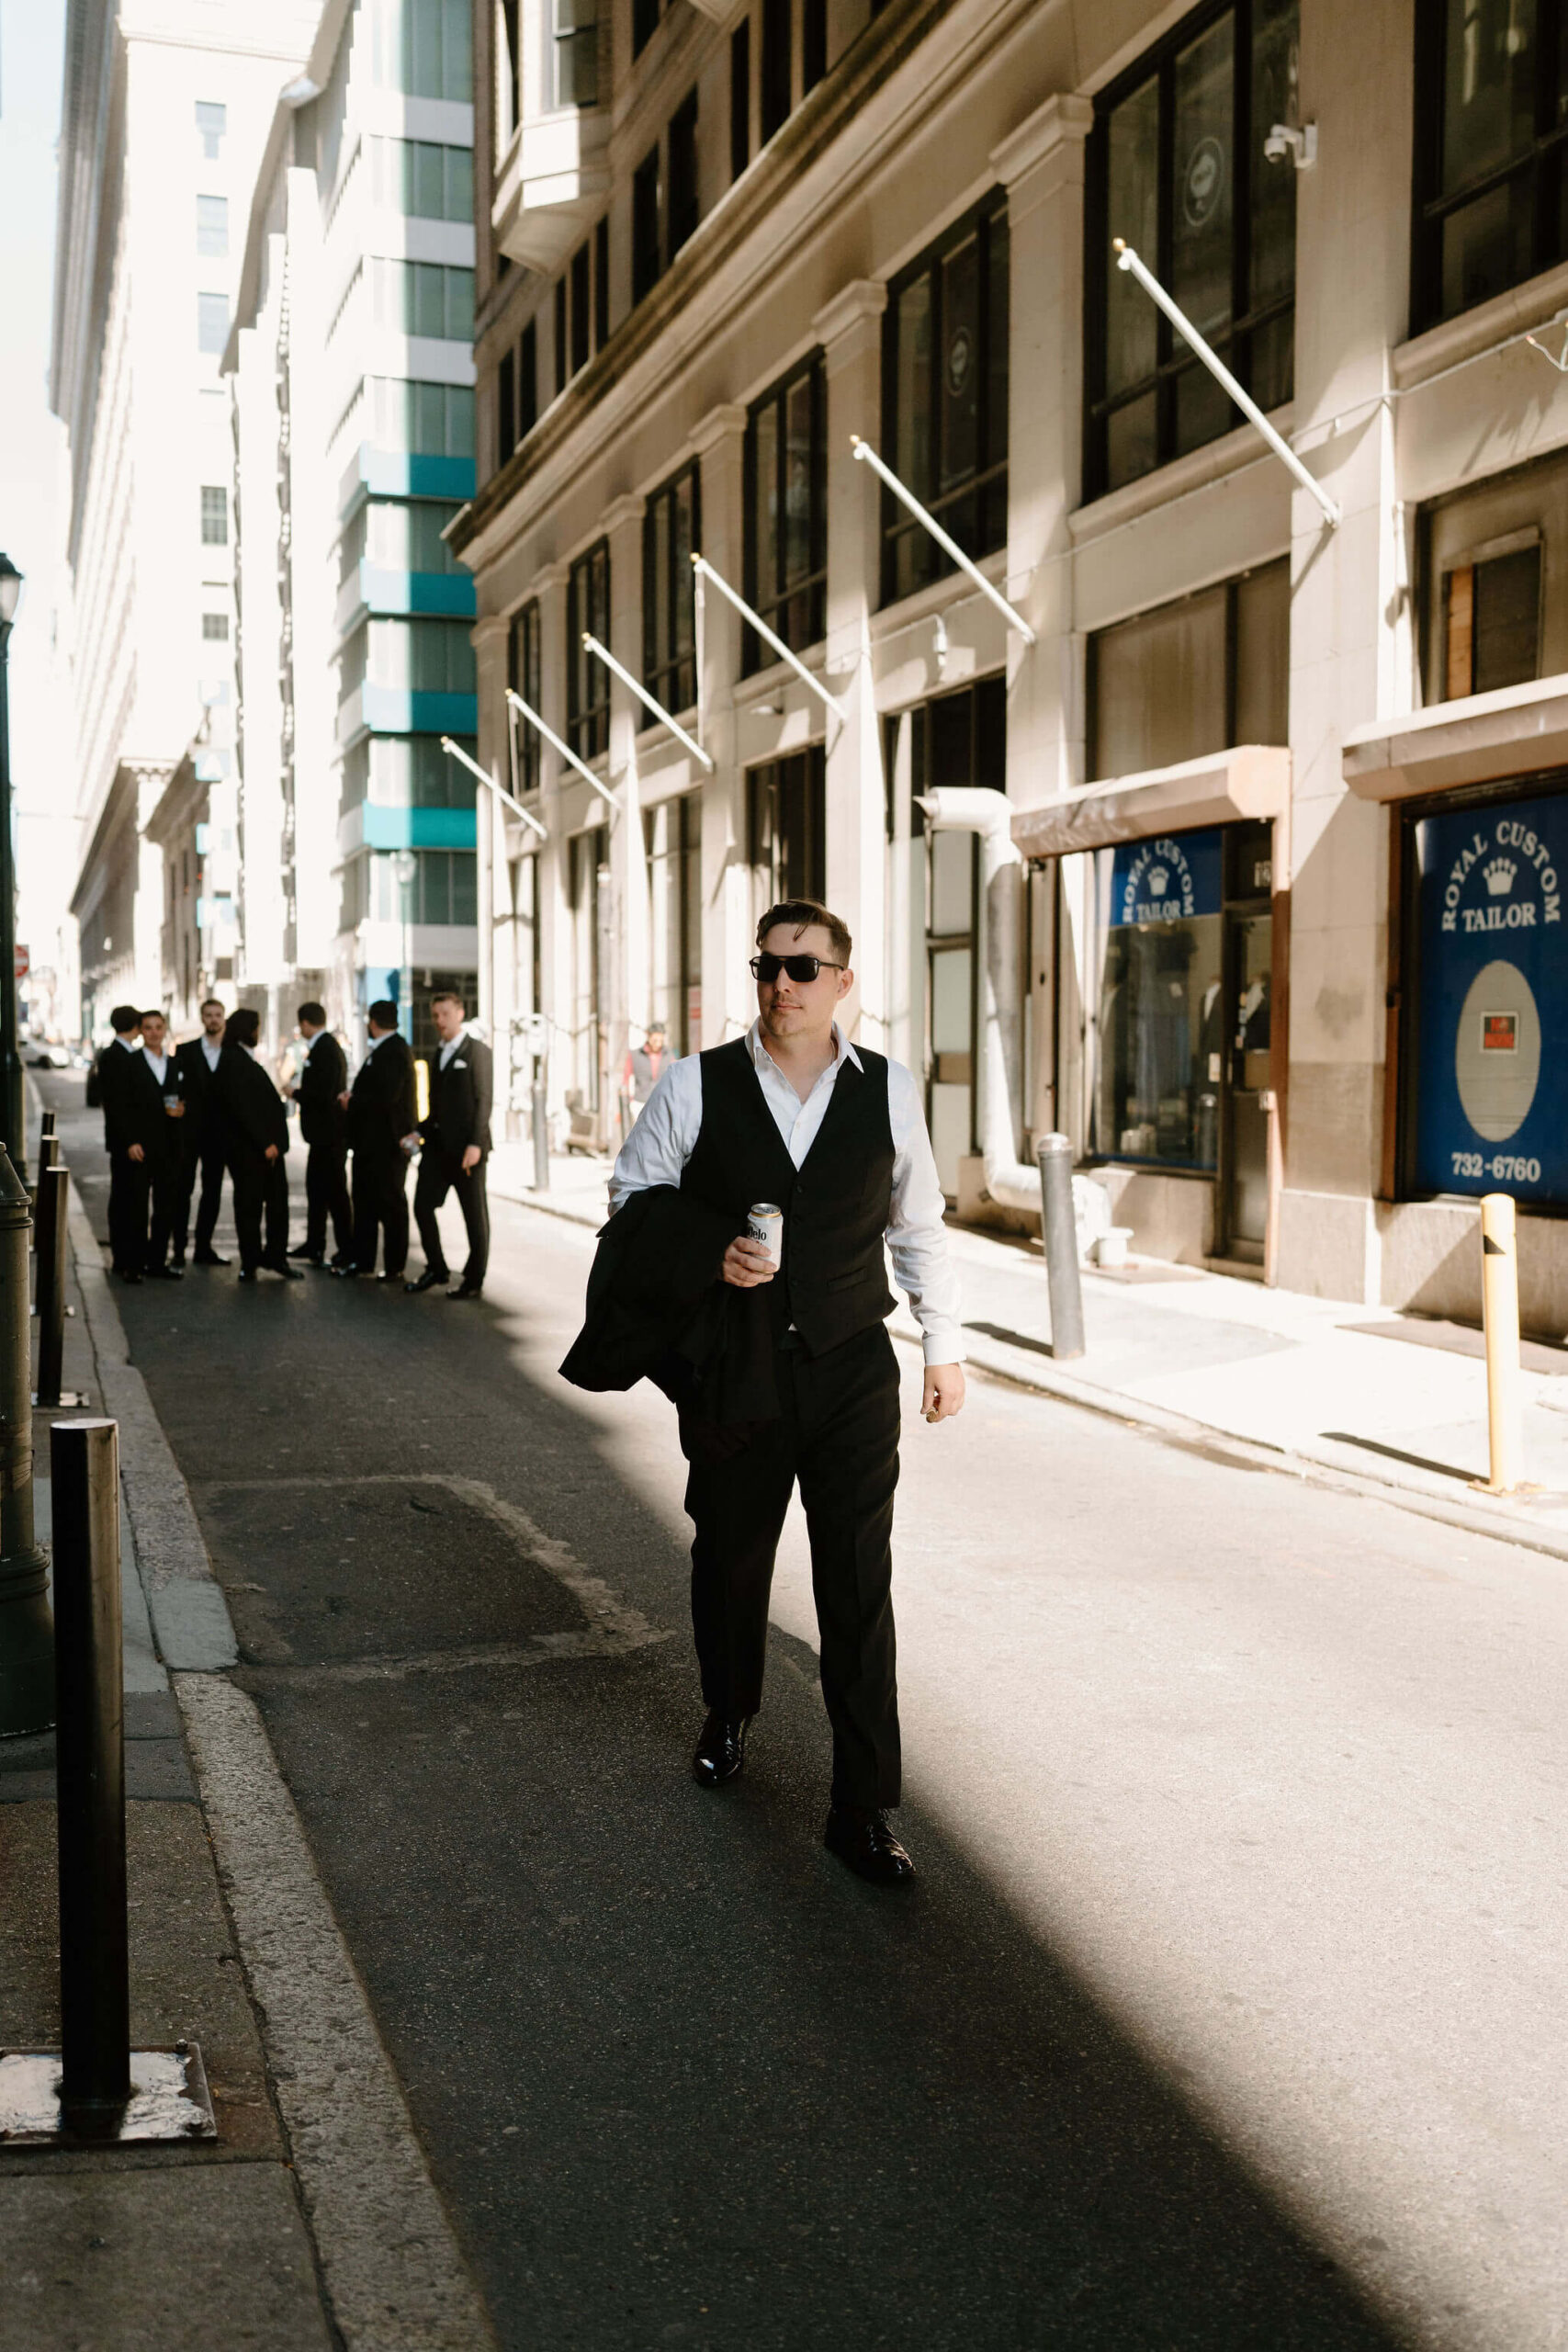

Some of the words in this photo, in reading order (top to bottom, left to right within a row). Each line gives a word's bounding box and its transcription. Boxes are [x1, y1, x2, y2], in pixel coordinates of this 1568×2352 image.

[1122, 846, 1152, 922] ROYAL
[1155, 838, 1194, 916] CUSTOM
[1441, 832, 1488, 933] ROYAL
[1495, 820, 1561, 923] CUSTOM
[1136, 899, 1181, 922] TAILOR
[1461, 902, 1537, 933] TAILOR
[1451, 1151, 1541, 1182] 732-6760
